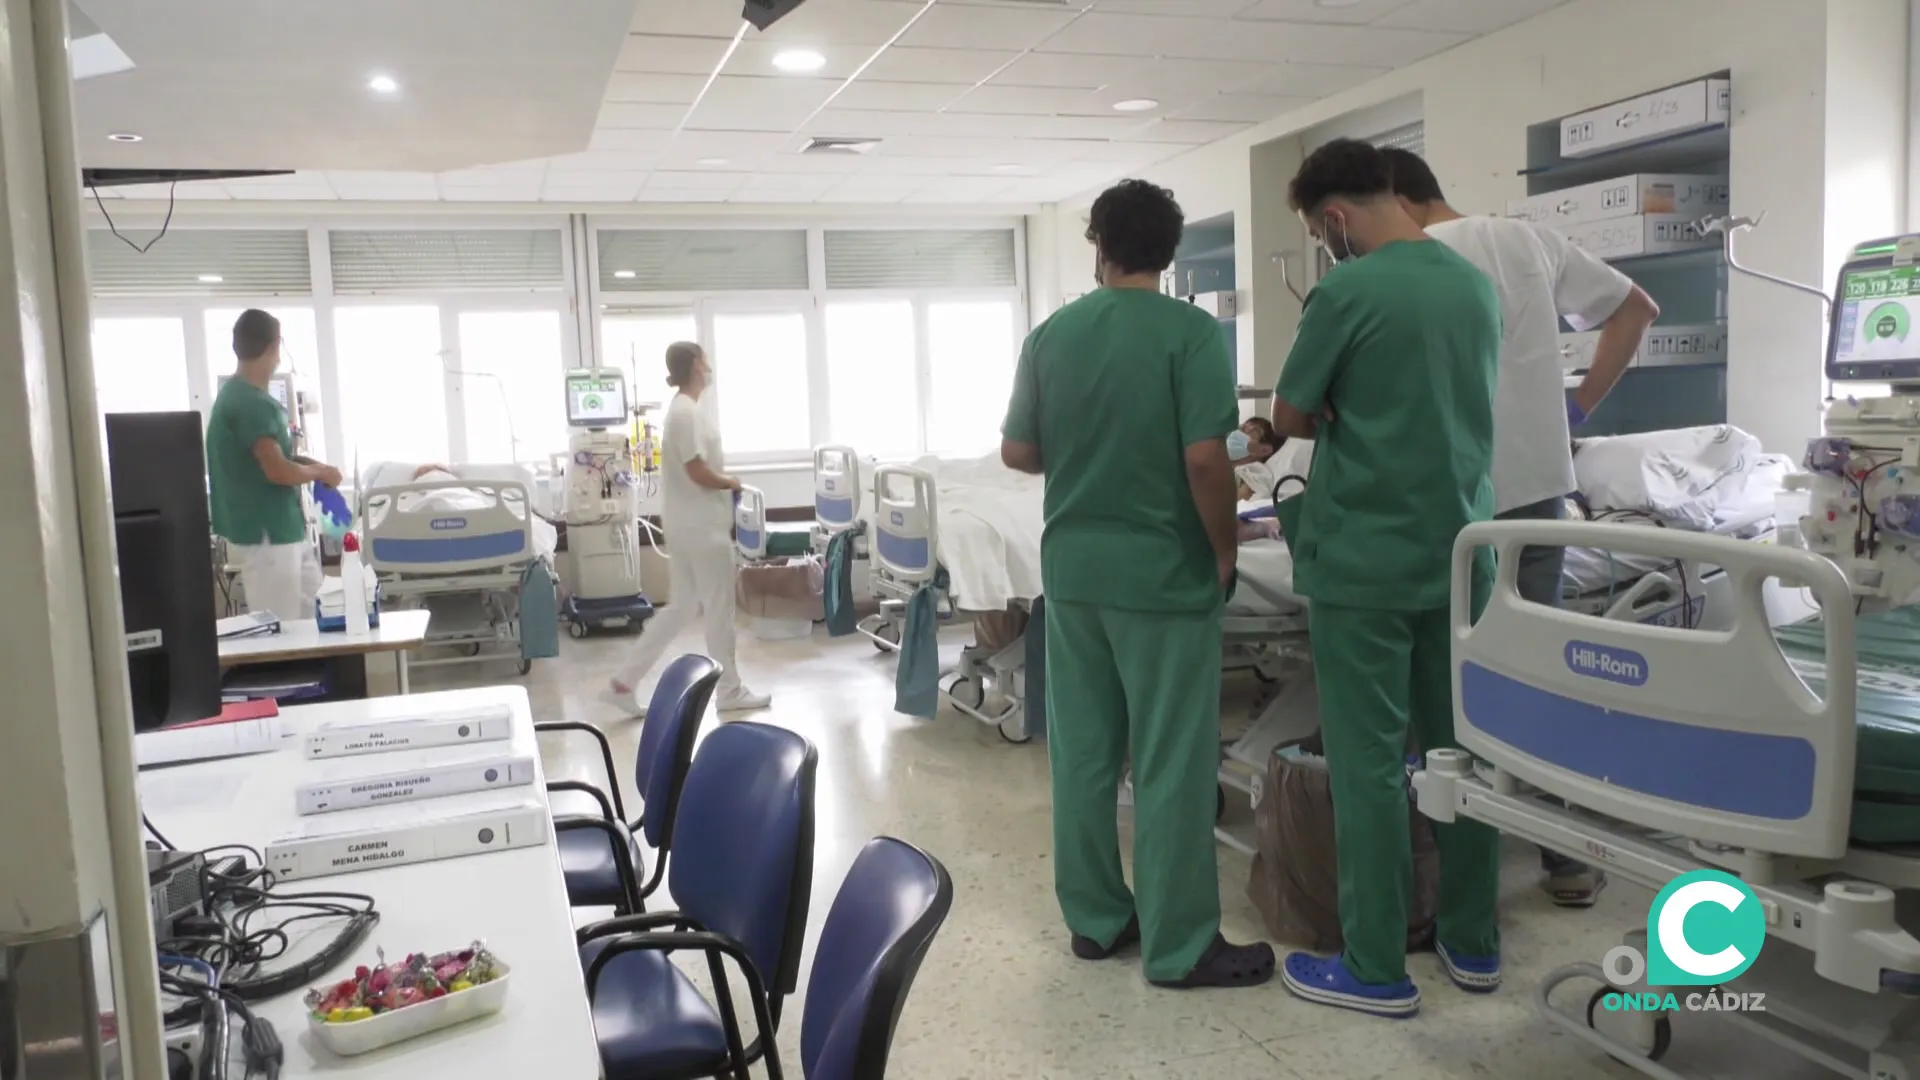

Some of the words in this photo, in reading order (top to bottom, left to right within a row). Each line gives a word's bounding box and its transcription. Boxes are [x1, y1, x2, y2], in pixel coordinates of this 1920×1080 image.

[1571, 647, 1641, 679] Hill-Rom
[351, 782, 393, 793] GREGORIA
[347, 840, 388, 853] CARMEN
[332, 857, 360, 866] MENA
[362, 850, 405, 863] HIDALGO
